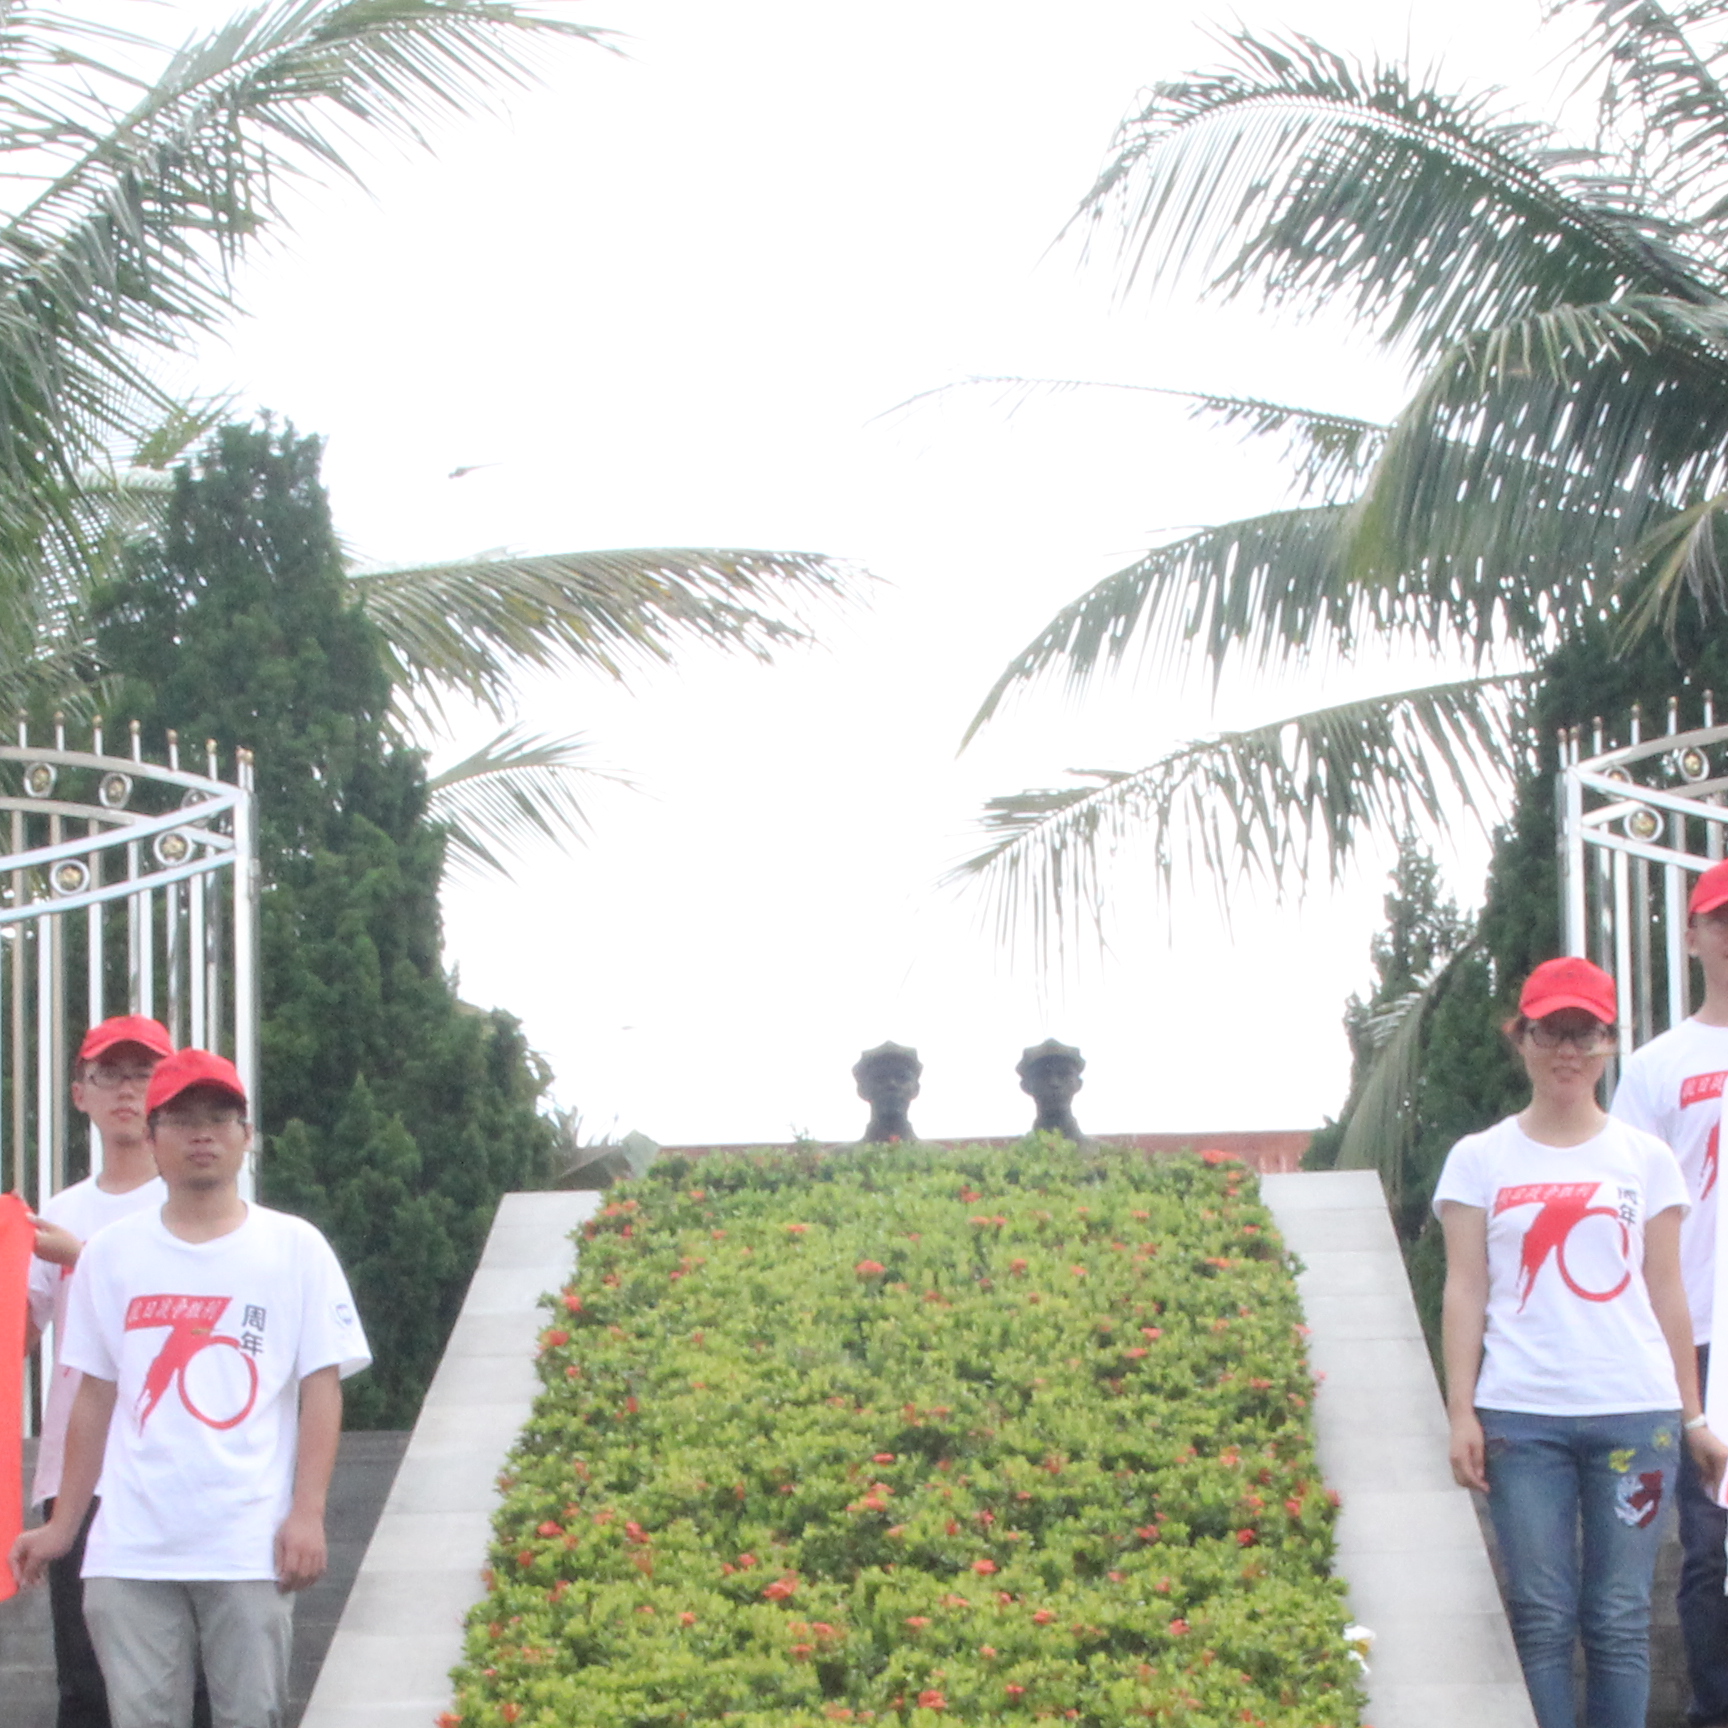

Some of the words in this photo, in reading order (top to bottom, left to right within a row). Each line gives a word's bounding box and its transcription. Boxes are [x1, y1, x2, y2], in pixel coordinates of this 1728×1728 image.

[1493, 1182, 1631, 1314] 70
[124, 1294, 258, 1438] 70
[240, 1303, 267, 1357] 周年
